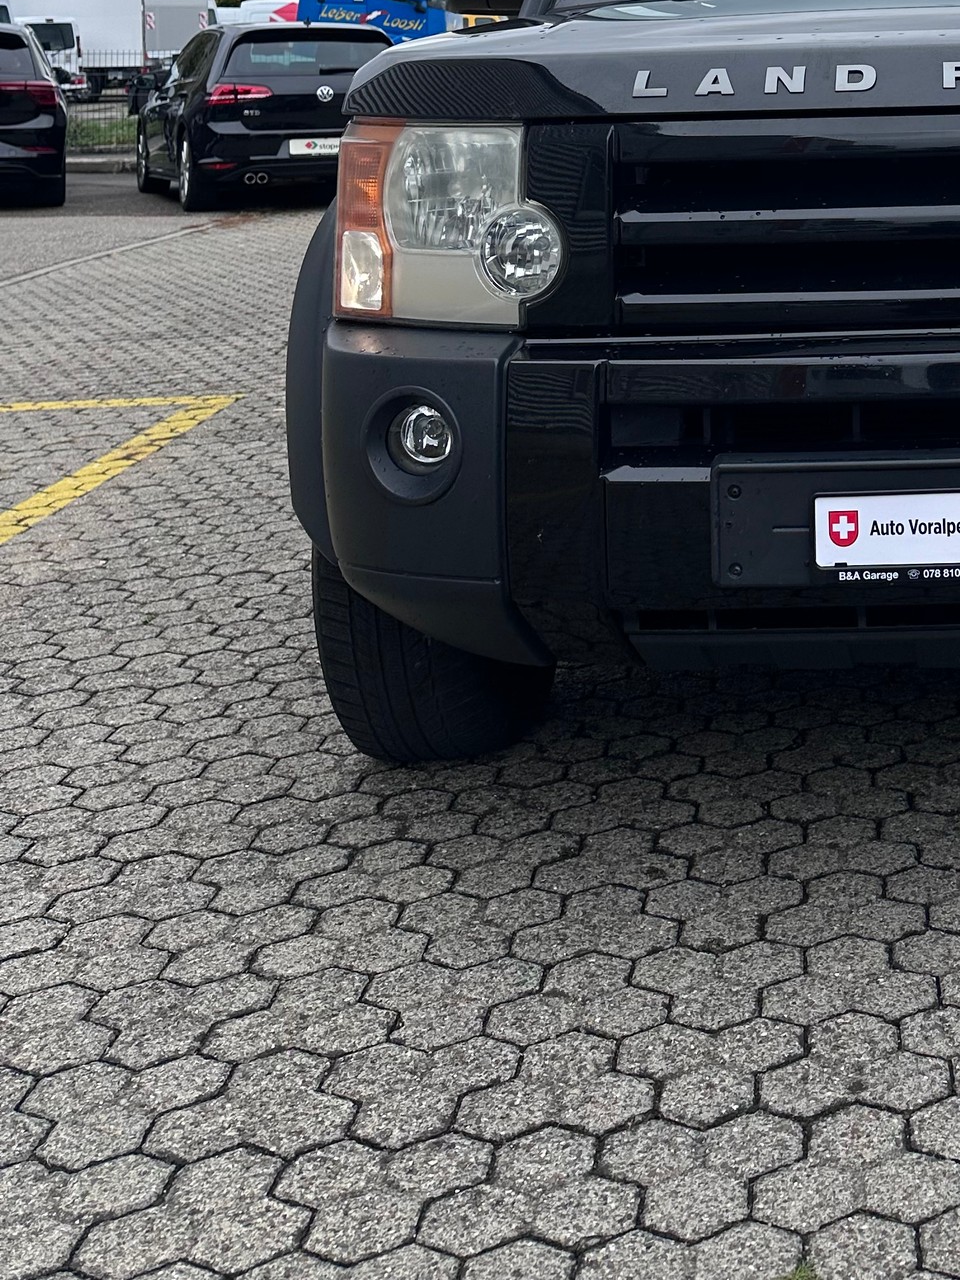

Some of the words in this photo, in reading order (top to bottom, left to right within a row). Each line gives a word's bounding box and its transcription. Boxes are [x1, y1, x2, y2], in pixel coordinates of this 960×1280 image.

[632, 64, 878, 98] LAND
[870, 520, 905, 536] Auto
[839, 572, 861, 581] B&A
[863, 570, 899, 582] Garage
[923, 569, 941, 579] 078
[943, 568, 960, 578] 810
